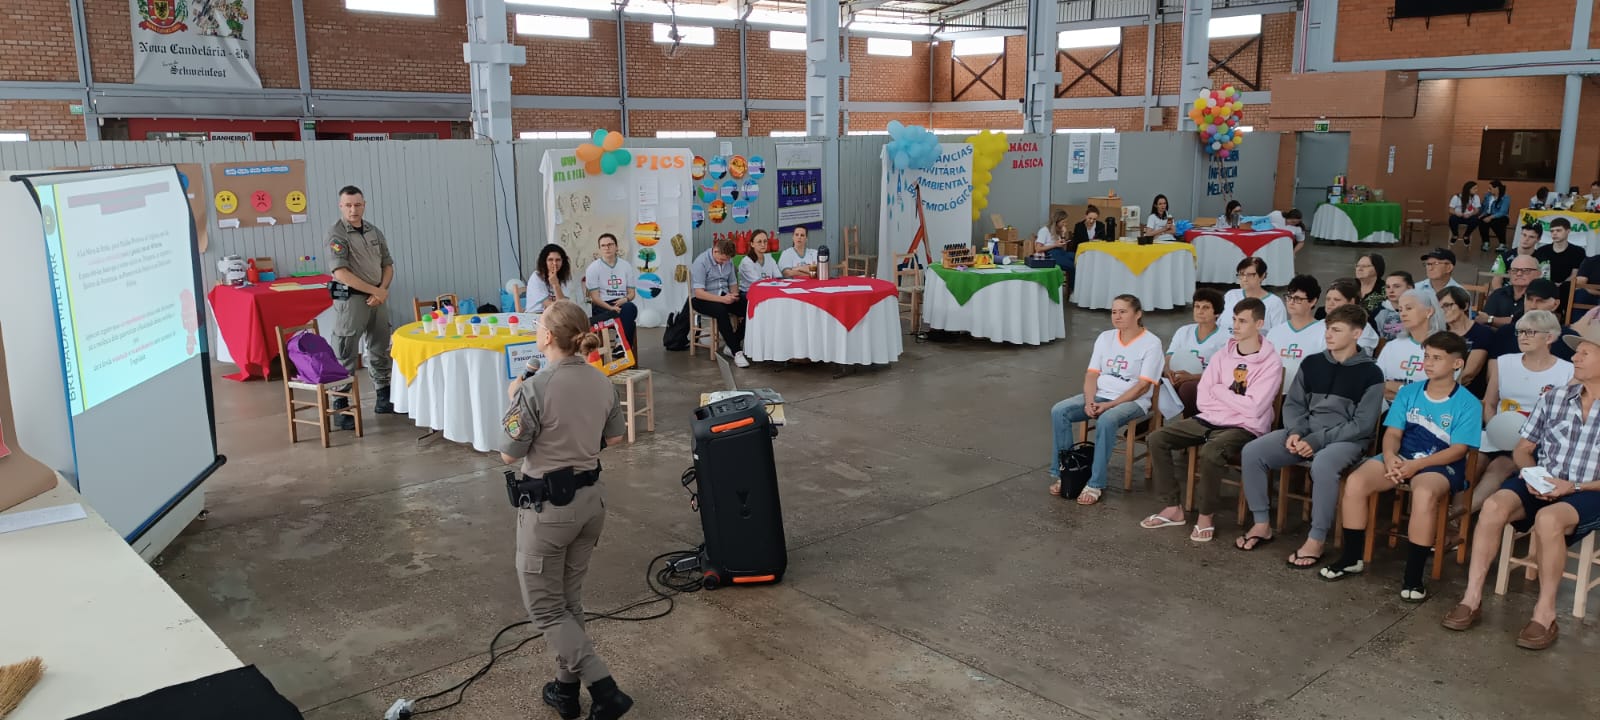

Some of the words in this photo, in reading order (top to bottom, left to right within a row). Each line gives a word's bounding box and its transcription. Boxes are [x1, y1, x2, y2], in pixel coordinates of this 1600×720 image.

[138, 41, 167, 54] Nova
[169, 43, 226, 57] Candelária
[170, 66, 227, 78] Schweinfest
[636, 155, 685, 170] PICS
[1013, 154, 1043, 169] BÁSICA
[917, 176, 969, 191] AMBIENTAL
[61, 326, 77, 402] BRIGADA
